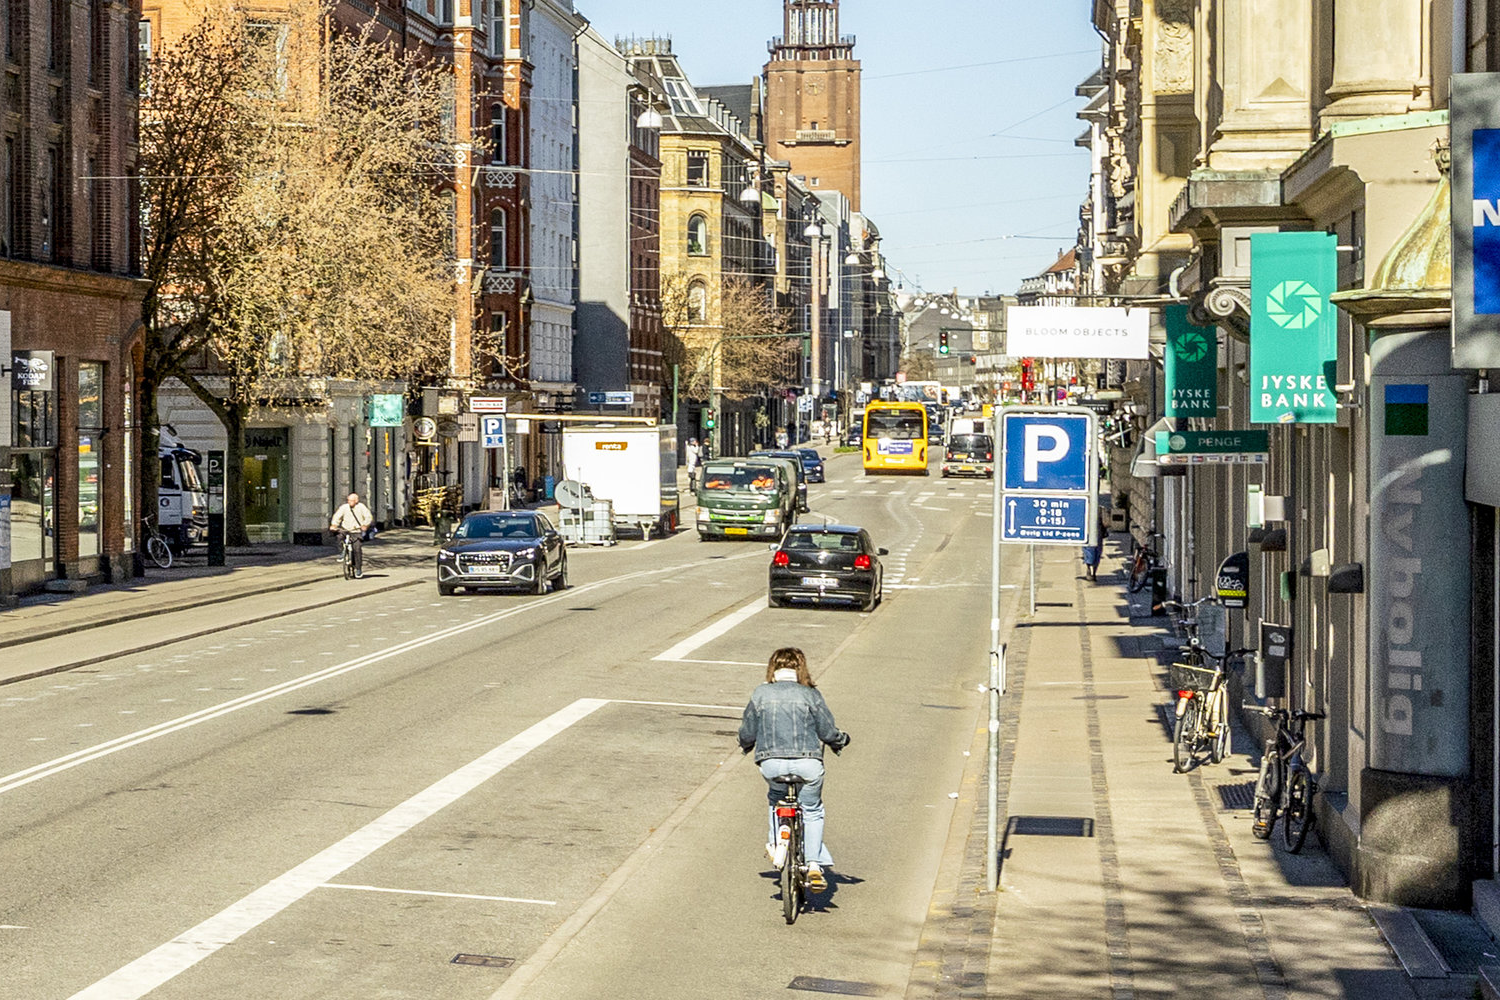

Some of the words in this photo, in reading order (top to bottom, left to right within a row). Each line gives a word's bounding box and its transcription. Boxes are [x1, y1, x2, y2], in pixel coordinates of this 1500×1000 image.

[1025, 328, 1068, 336] BLOOM
[1073, 328, 1129, 337] OBJECTS
[1261, 375, 1327, 390] JYSKE
[1171, 388, 1211, 398] JYSKE
[1171, 399, 1211, 409] BANK
[1261, 393, 1327, 408] BANK
[487, 418, 503, 434] P
[1198, 437, 1242, 447] PENGE
[1023, 424, 1070, 482] P
[1033, 499, 1048, 508] 30
[1050, 500, 1070, 509] min
[1039, 508, 1063, 517] 9-18
[1035, 516, 1067, 526] (9-15)
